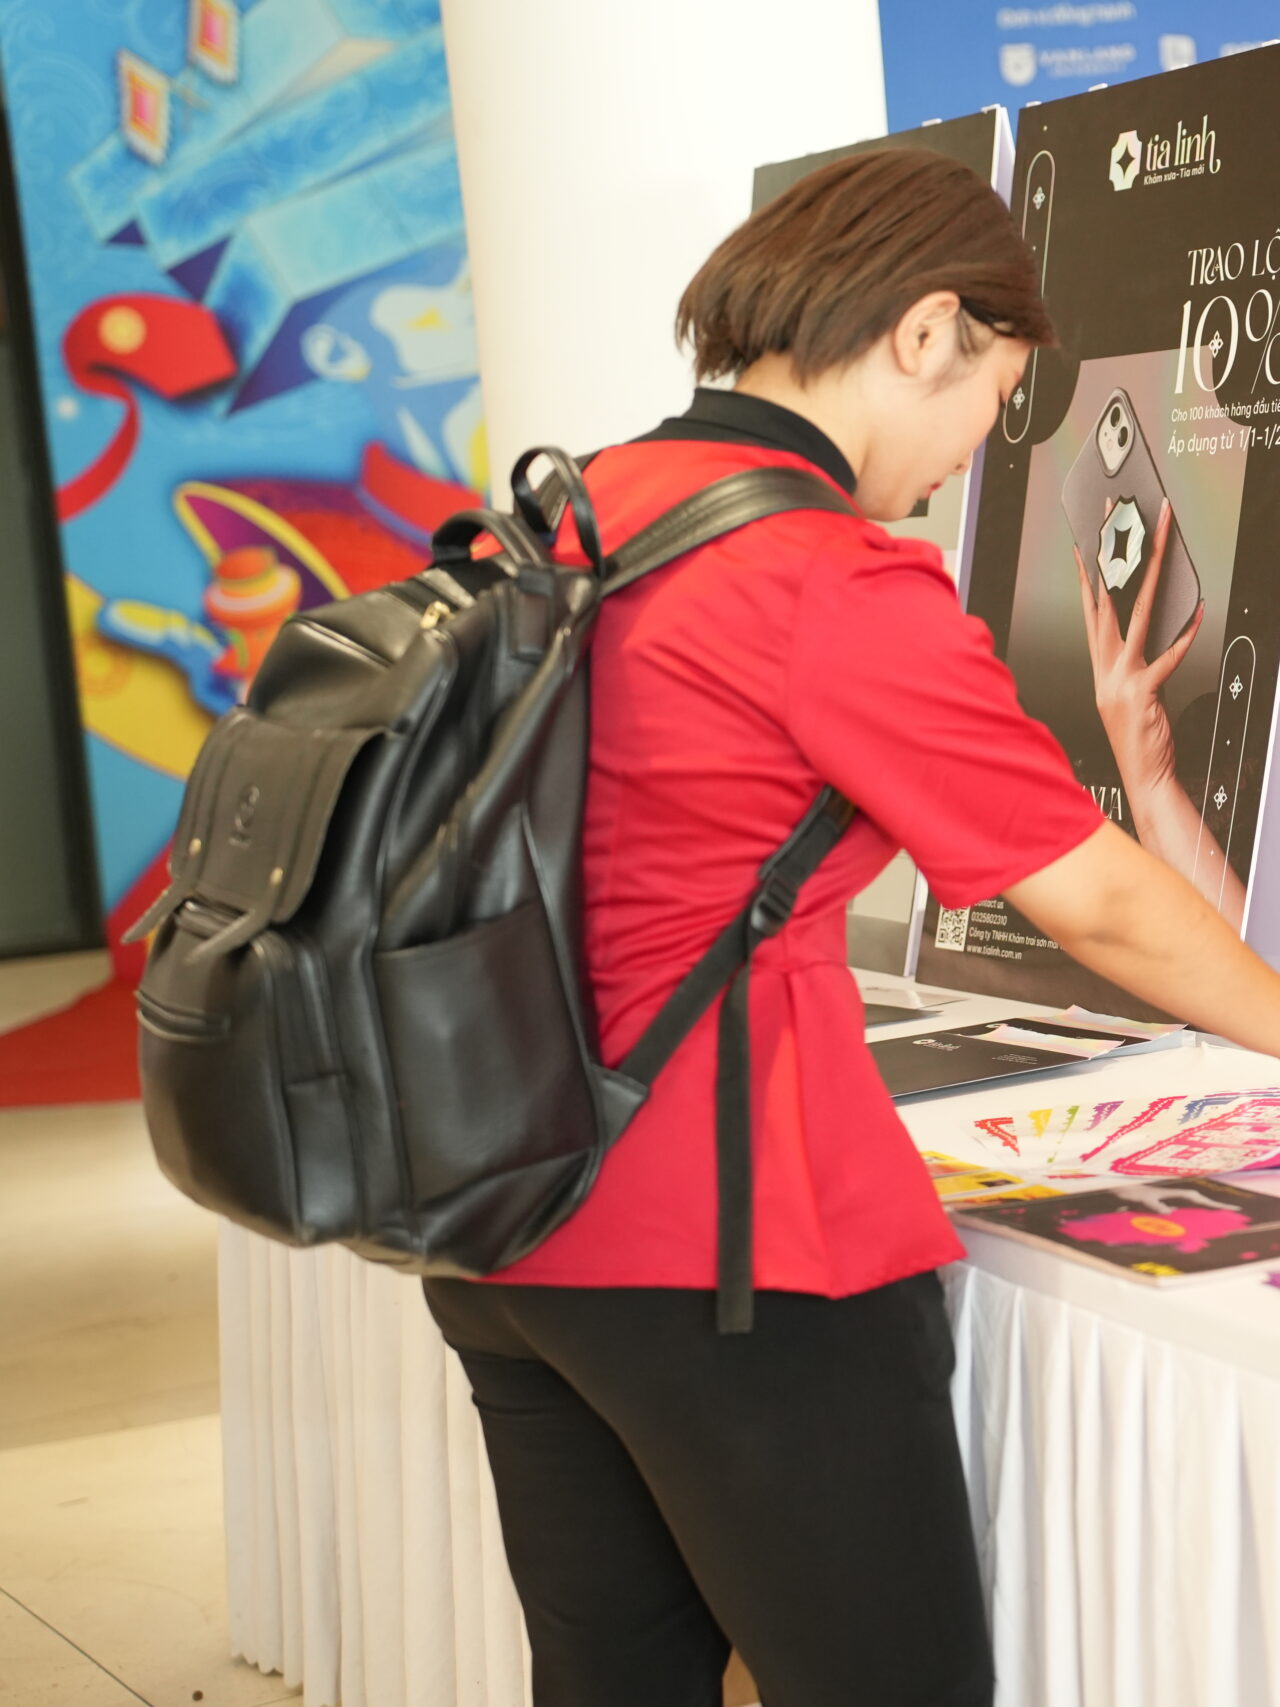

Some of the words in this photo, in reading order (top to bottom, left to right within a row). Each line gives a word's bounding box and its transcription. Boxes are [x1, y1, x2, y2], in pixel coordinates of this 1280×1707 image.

[1146, 134, 1170, 171] tia
[1174, 114, 1221, 174] linh
[1143, 173, 1163, 186] Khảm
[1187, 242, 1245, 286] TRAO
[1171, 408, 1188, 422] Cho
[1189, 405, 1204, 421] 100
[1204, 404, 1230, 420] khách
[1230, 401, 1252, 418] hàng
[1253, 397, 1270, 415] đầu
[1167, 429, 1185, 457] Áp
[1187, 433, 1218, 457] dụng
[1220, 429, 1235, 449] từ
[968, 926, 985, 941] Công
[984, 930, 992, 942] ty
[992, 929, 1008, 942] TNHH
